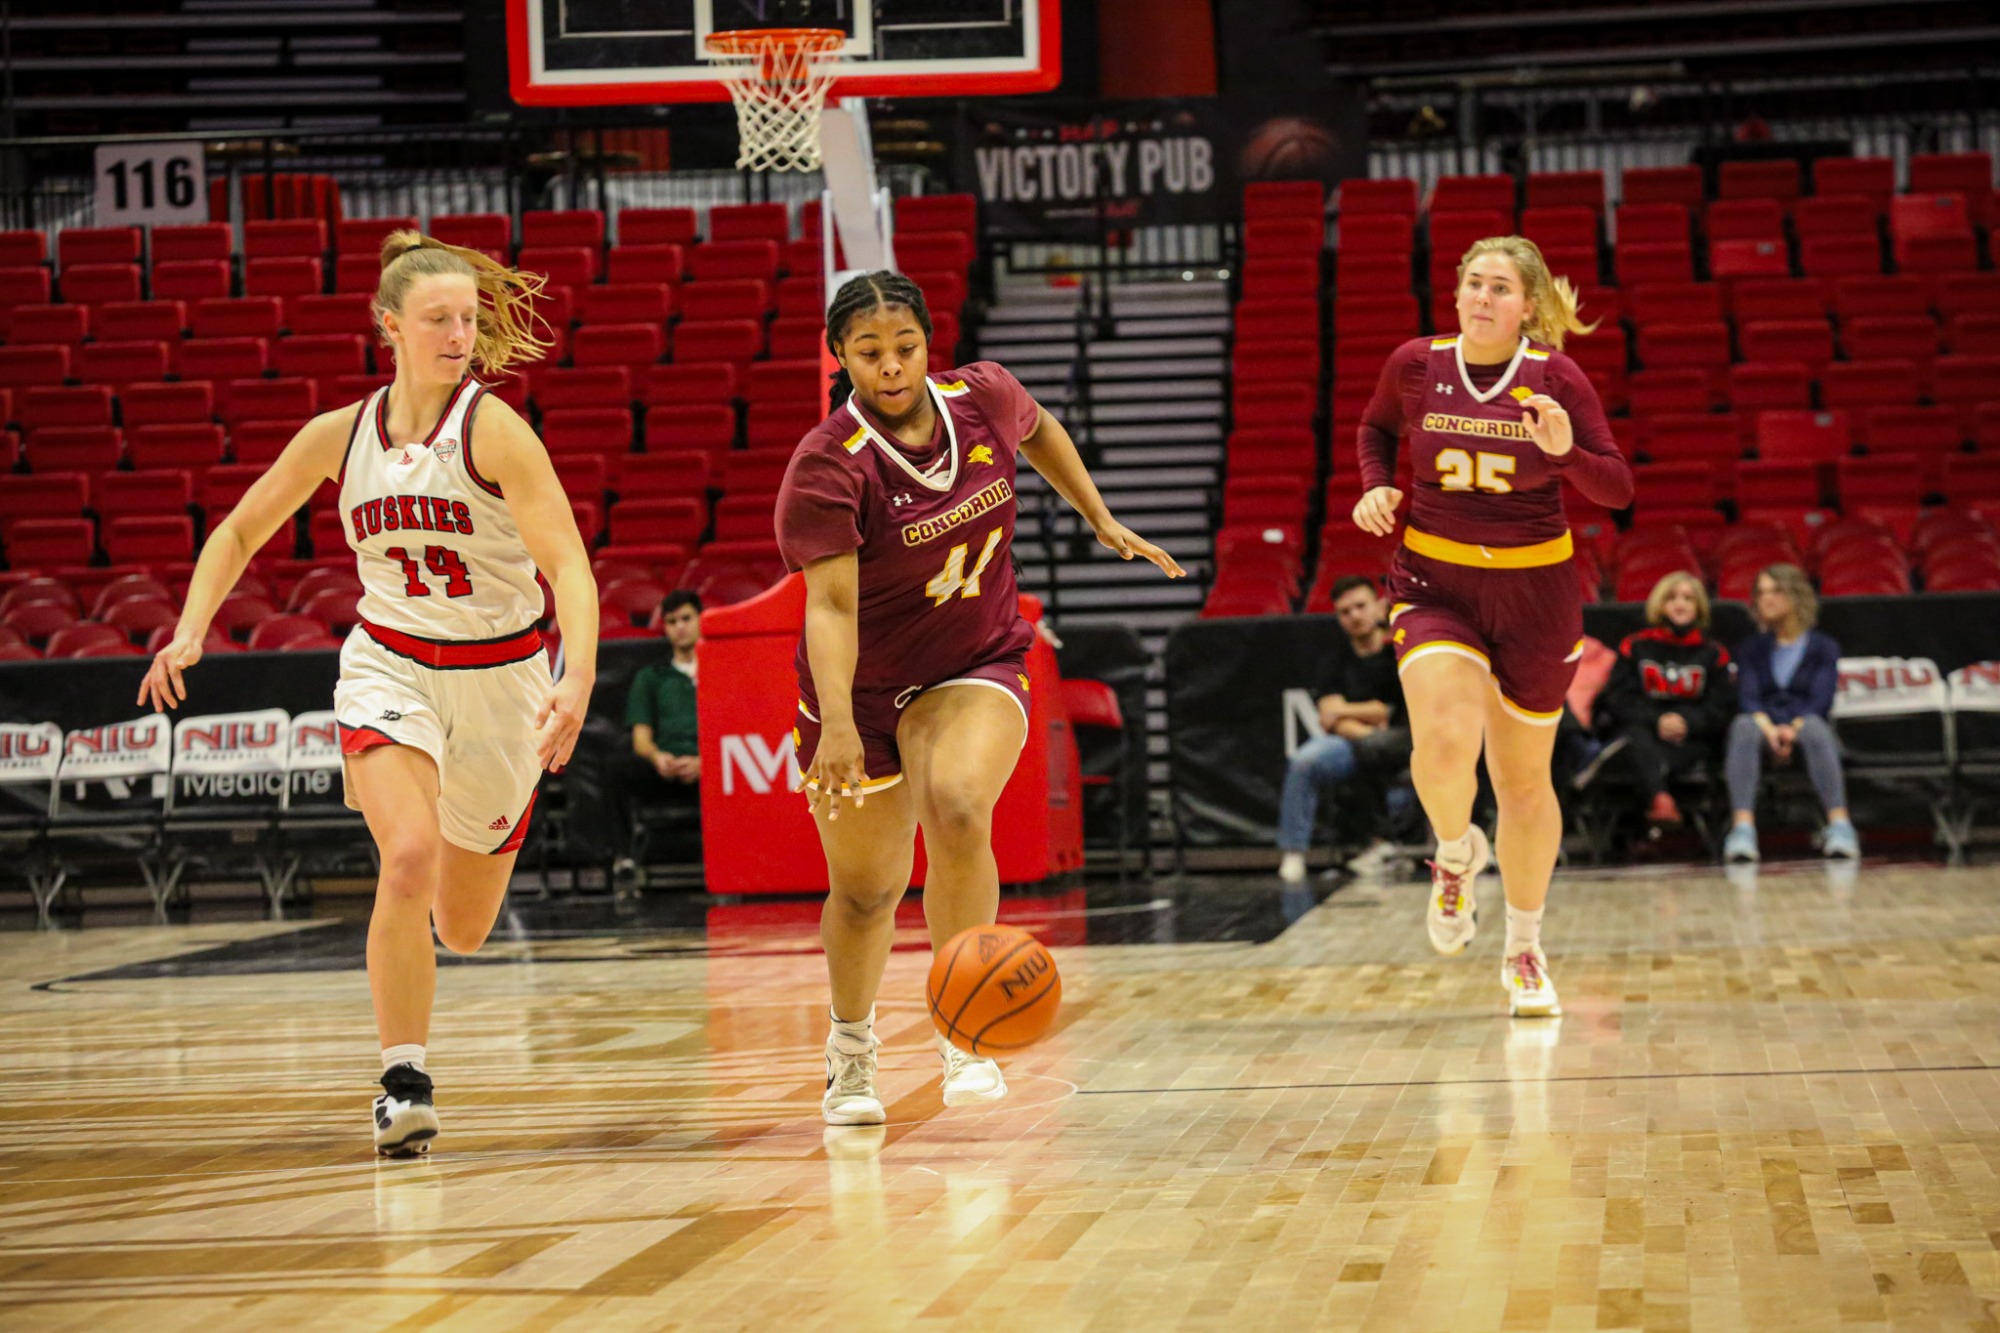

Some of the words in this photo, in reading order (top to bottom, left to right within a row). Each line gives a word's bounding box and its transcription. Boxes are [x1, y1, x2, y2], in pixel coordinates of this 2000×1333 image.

[105, 156, 196, 209] 116
[1139, 136, 1214, 195] PUB
[351, 495, 474, 543] HUSKIES
[901, 477, 1013, 547] CONCORDIA
[385, 544, 473, 598] 14
[1837, 666, 1933, 692] NIU
[65, 726, 157, 755] NIU
[182, 721, 277, 750] NIU
[1000, 951, 1049, 1000] NIU
